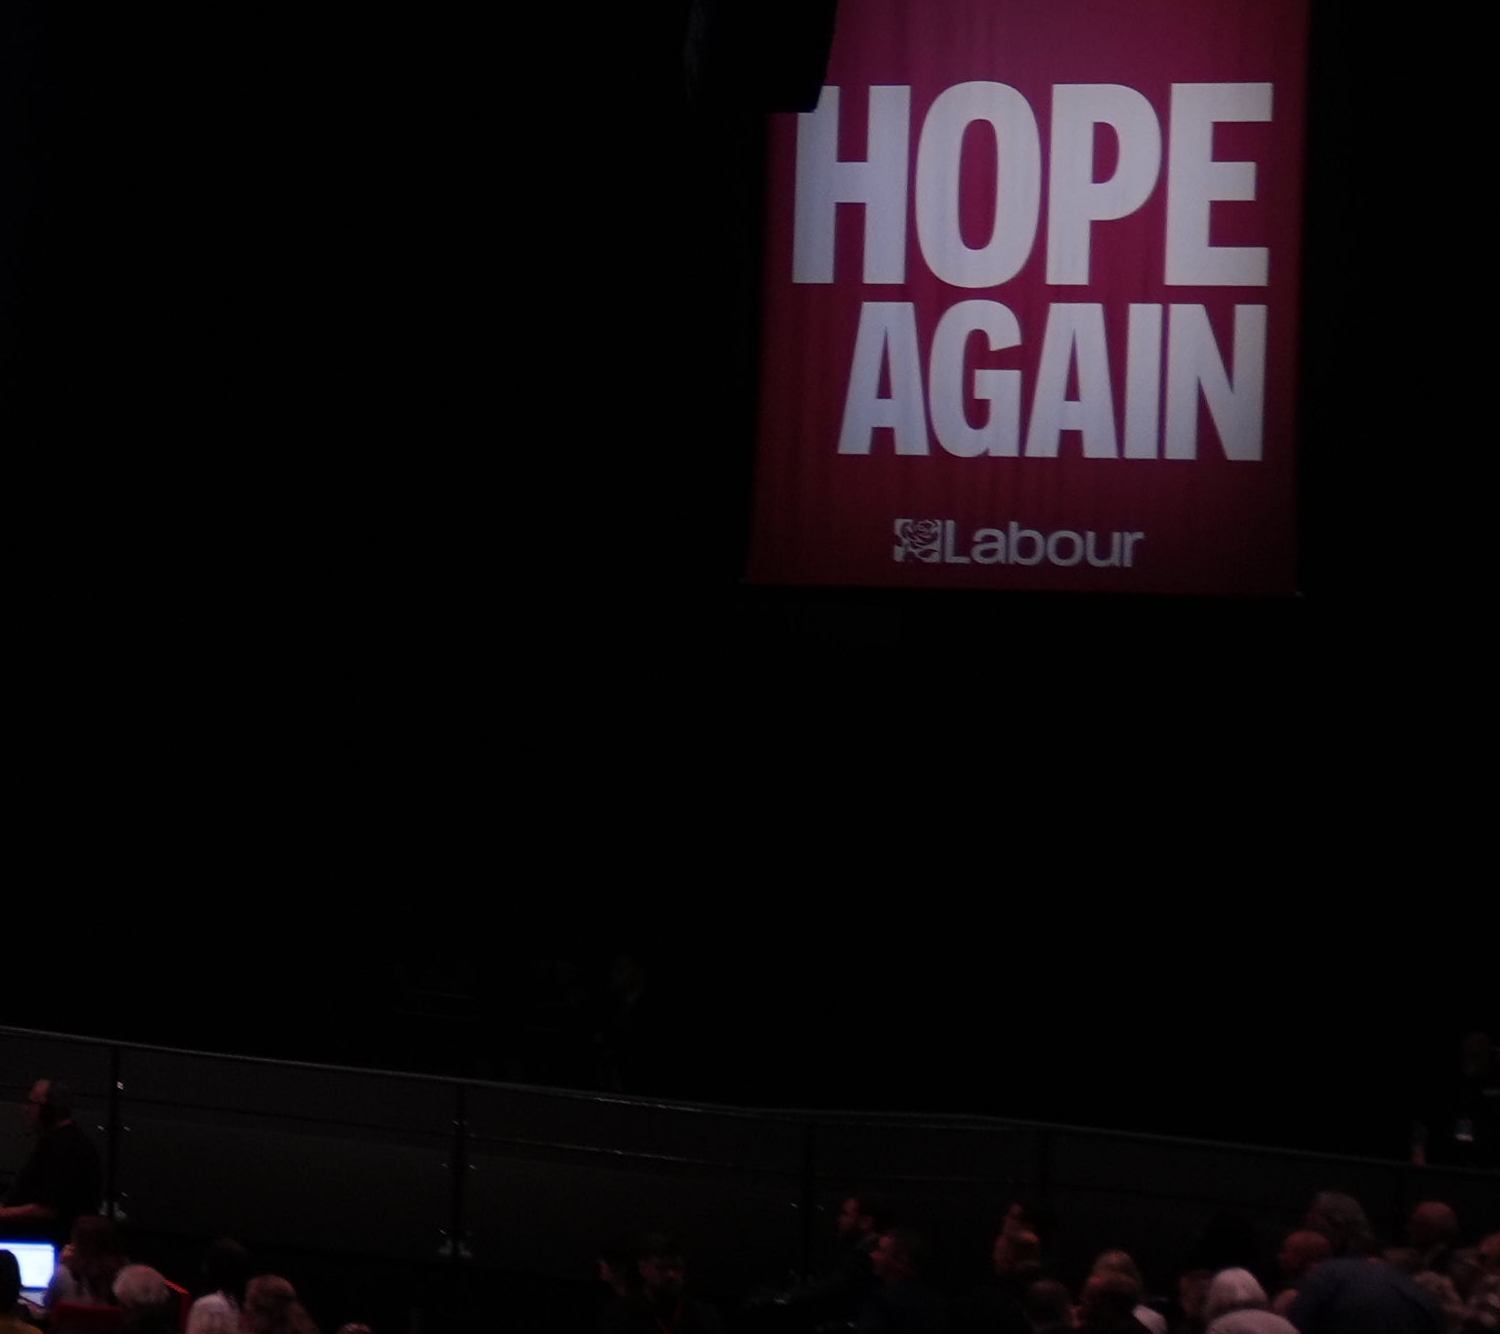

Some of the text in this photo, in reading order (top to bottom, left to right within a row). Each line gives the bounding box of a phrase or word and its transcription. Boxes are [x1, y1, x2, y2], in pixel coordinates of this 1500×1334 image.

[791, 80, 1275, 289] HOPE
[836, 299, 1268, 462] AGAIN
[943, 519, 1146, 568] Labour
